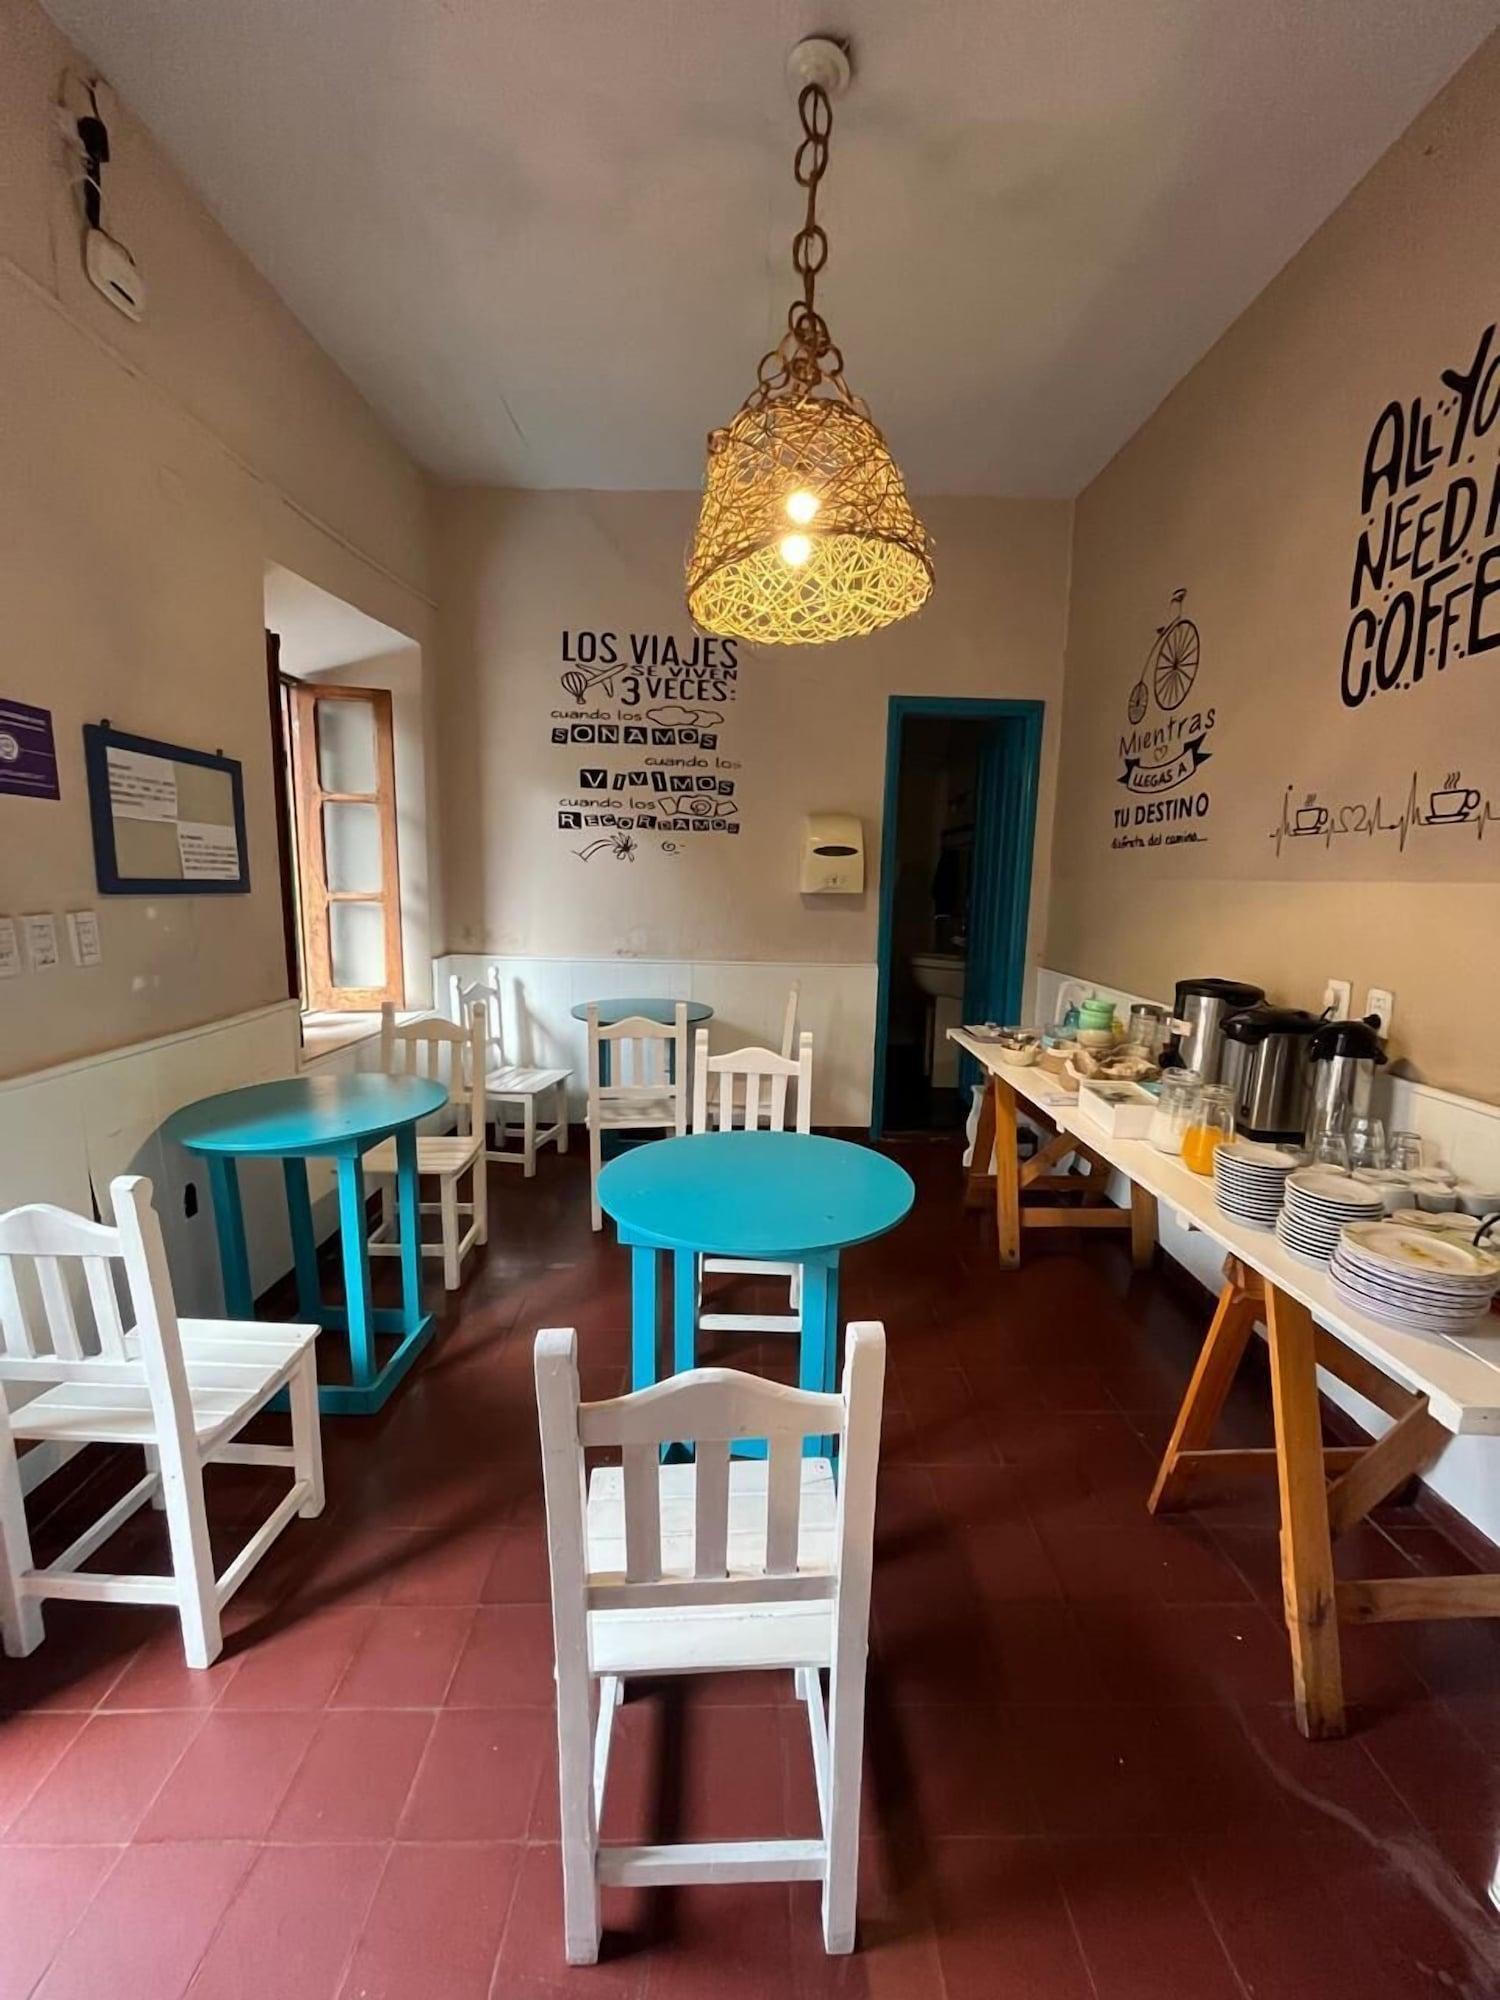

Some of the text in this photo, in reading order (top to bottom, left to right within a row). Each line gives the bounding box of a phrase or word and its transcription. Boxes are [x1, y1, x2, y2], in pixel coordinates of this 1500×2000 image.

[1361, 396, 1444, 514] ALL
[1350, 476, 1478, 610] NEED
[562, 631, 738, 669] LOS VIAJES
[630, 665, 738, 681] SE VIVEN
[621, 676, 641, 706] 3
[550, 708, 643, 722] cuando los
[1119, 708, 1216, 758] Mientras
[644, 755, 742, 770] cuando los
[1132, 761, 1188, 788] LLEGAS A
[580, 769, 736, 796] VIVIMOS
[558, 796, 657, 810] cuando los
[1114, 792, 1210, 829] TU DESTINO
[558, 811, 740, 834] RECORDAMOS
[1148, 833, 1162, 847] del
